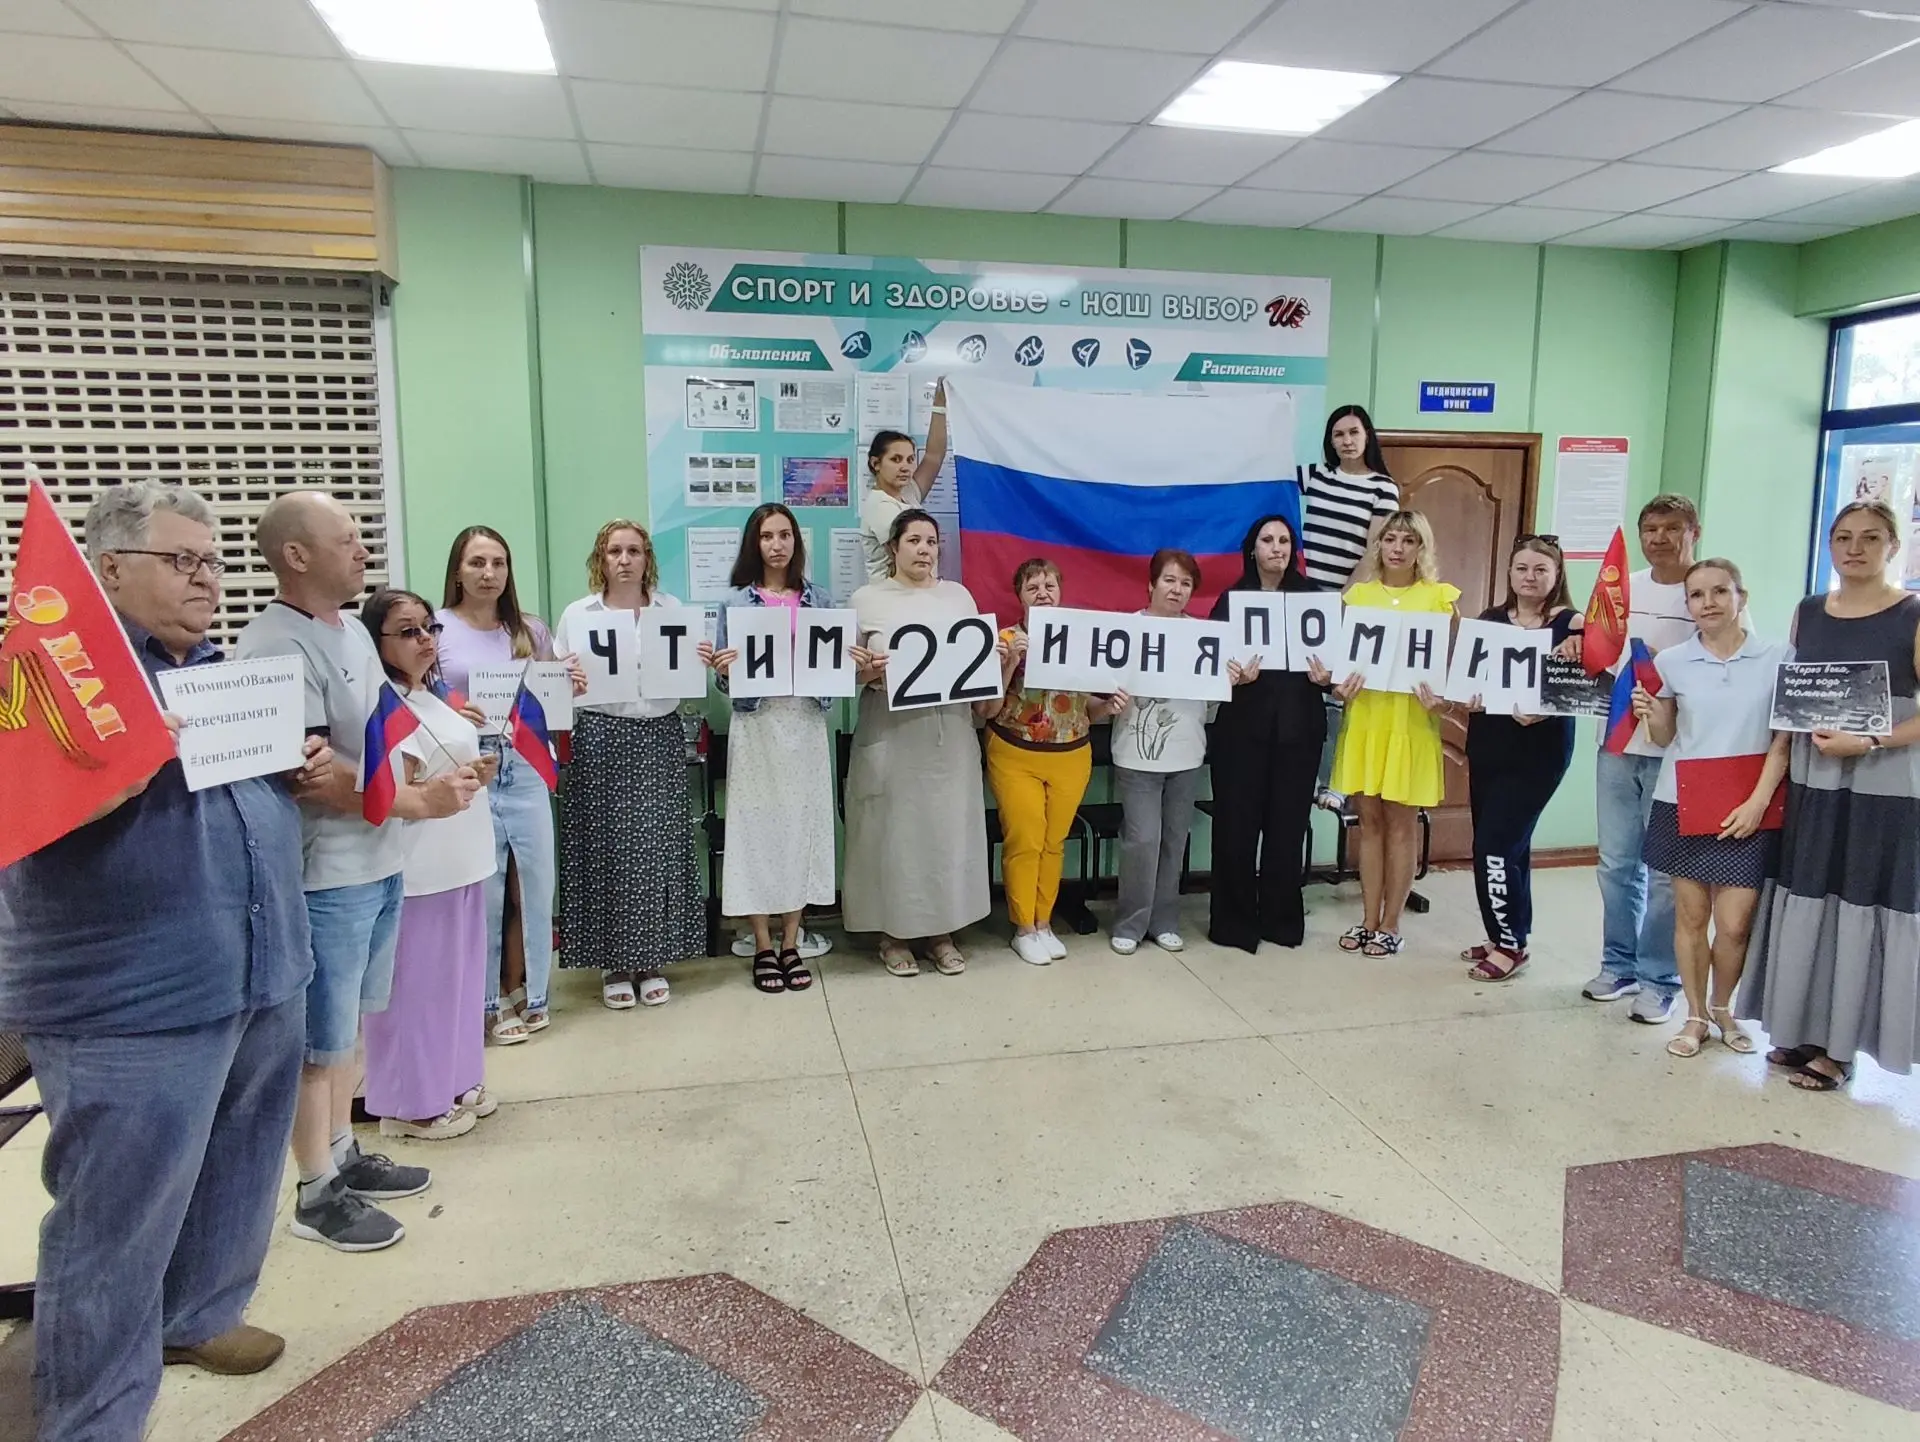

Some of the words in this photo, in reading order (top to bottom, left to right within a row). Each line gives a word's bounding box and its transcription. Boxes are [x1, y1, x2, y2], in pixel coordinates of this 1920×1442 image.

[731, 276, 836, 304] СПОРТ
[850, 282, 871, 305] И
[1163, 295, 1258, 322] ВЫБОР
[709, 343, 812, 362] Объявления
[1200, 359, 1286, 377] Расписание
[1426, 386, 1489, 397] МЕДИЦИНСКИЙ
[1443, 399, 1470, 409] ПУНКТ
[888, 617, 998, 708] 22
[1042, 623, 1220, 676] ИЮНЯ
[175, 672, 295, 696] #ПомнимОВажном
[187, 706, 278, 728] #свечапамяти
[190, 744, 273, 767] #деньпамяти
